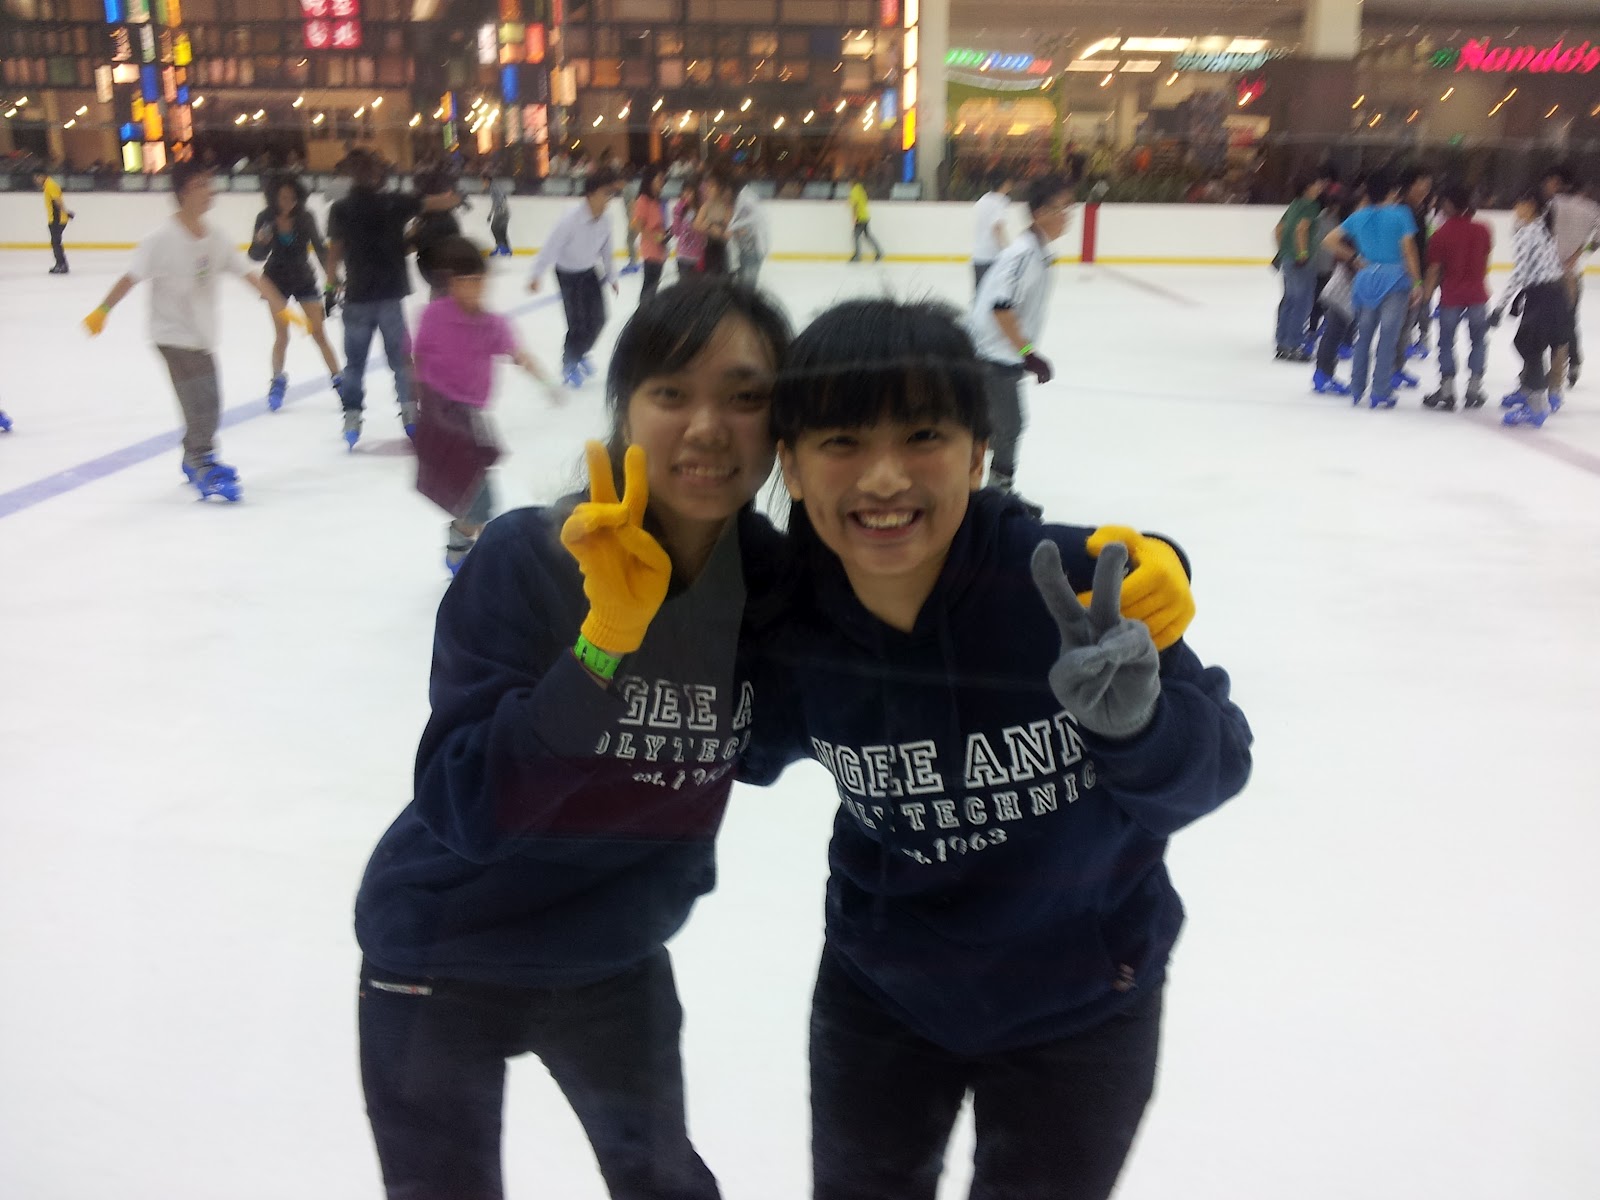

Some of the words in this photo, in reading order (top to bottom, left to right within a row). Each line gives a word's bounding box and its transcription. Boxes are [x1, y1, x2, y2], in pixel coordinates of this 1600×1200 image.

[615, 674, 718, 732] GEE
[810, 735, 945, 798] NGEE
[843, 760, 1097, 833] OLTECHNIC
